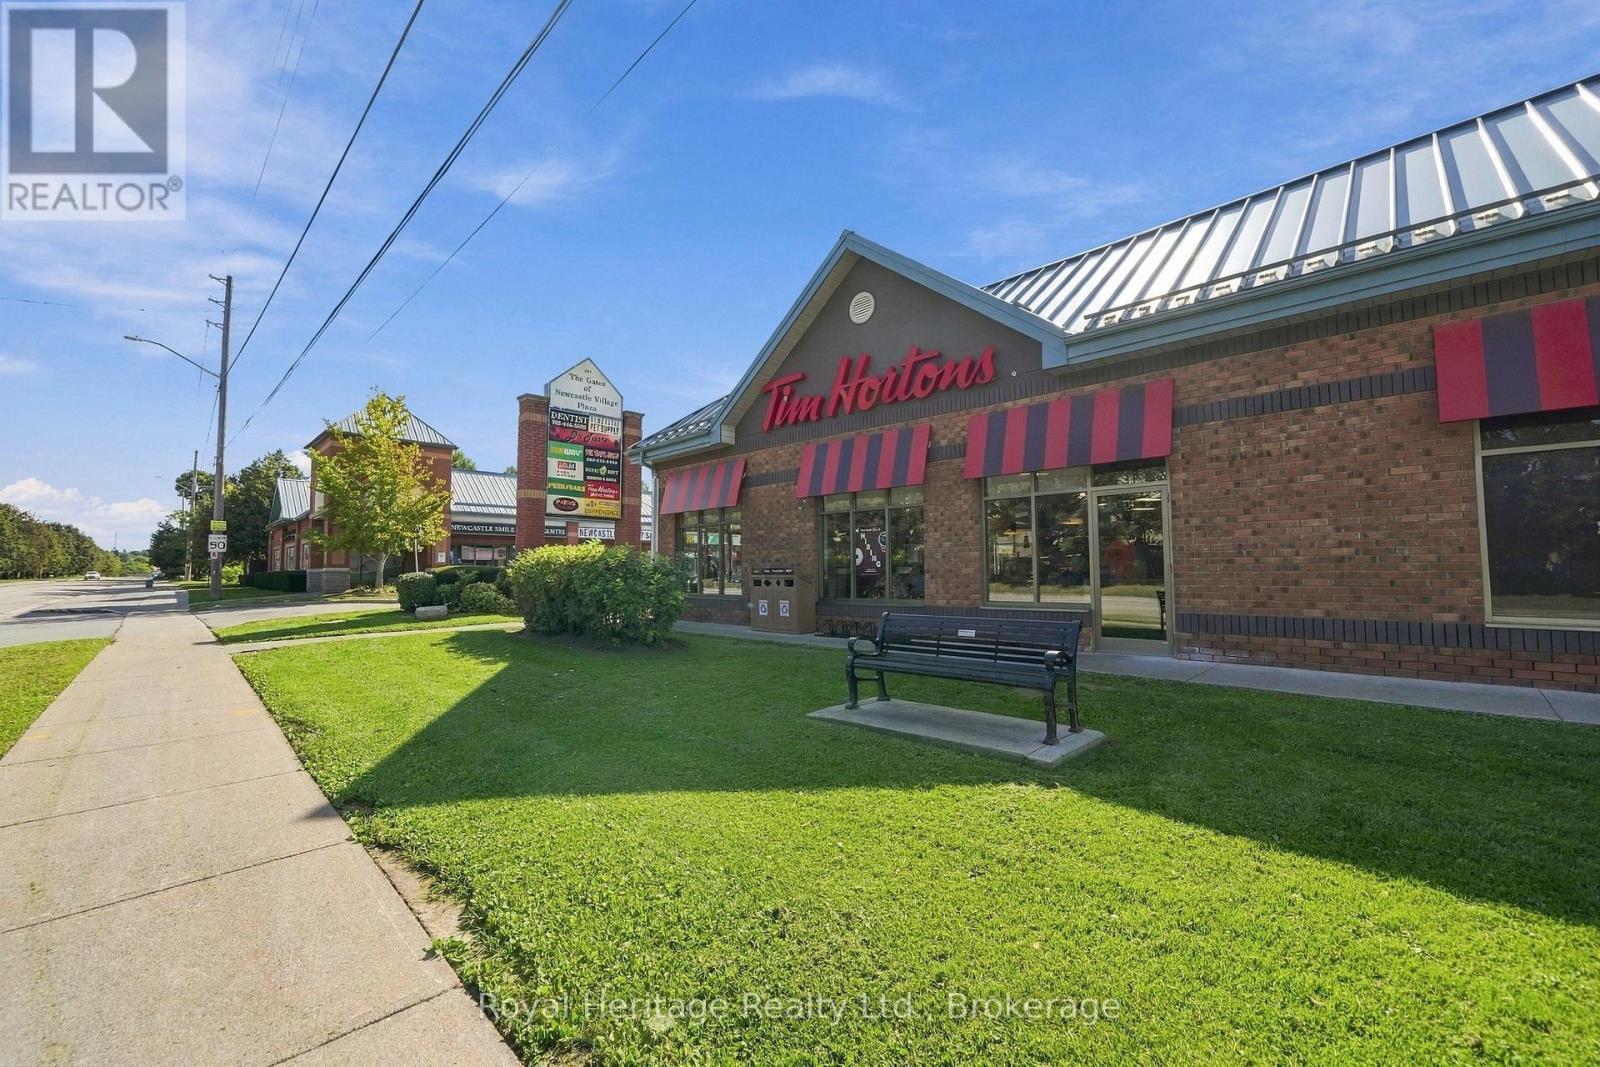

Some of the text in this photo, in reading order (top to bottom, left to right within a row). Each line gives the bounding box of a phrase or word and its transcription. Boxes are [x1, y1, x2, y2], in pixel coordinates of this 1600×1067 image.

[569, 373, 607, 387] The Gates
[583, 385, 592, 393] of
[761, 343, 996, 433] Tim Hortons
[555, 388, 619, 408] Newcastle Village
[577, 402, 597, 412] Plaza
[551, 411, 587, 424] DENTIST
[451, 524, 494, 532] NEWCASTLE
[210, 541, 226, 550] 50
